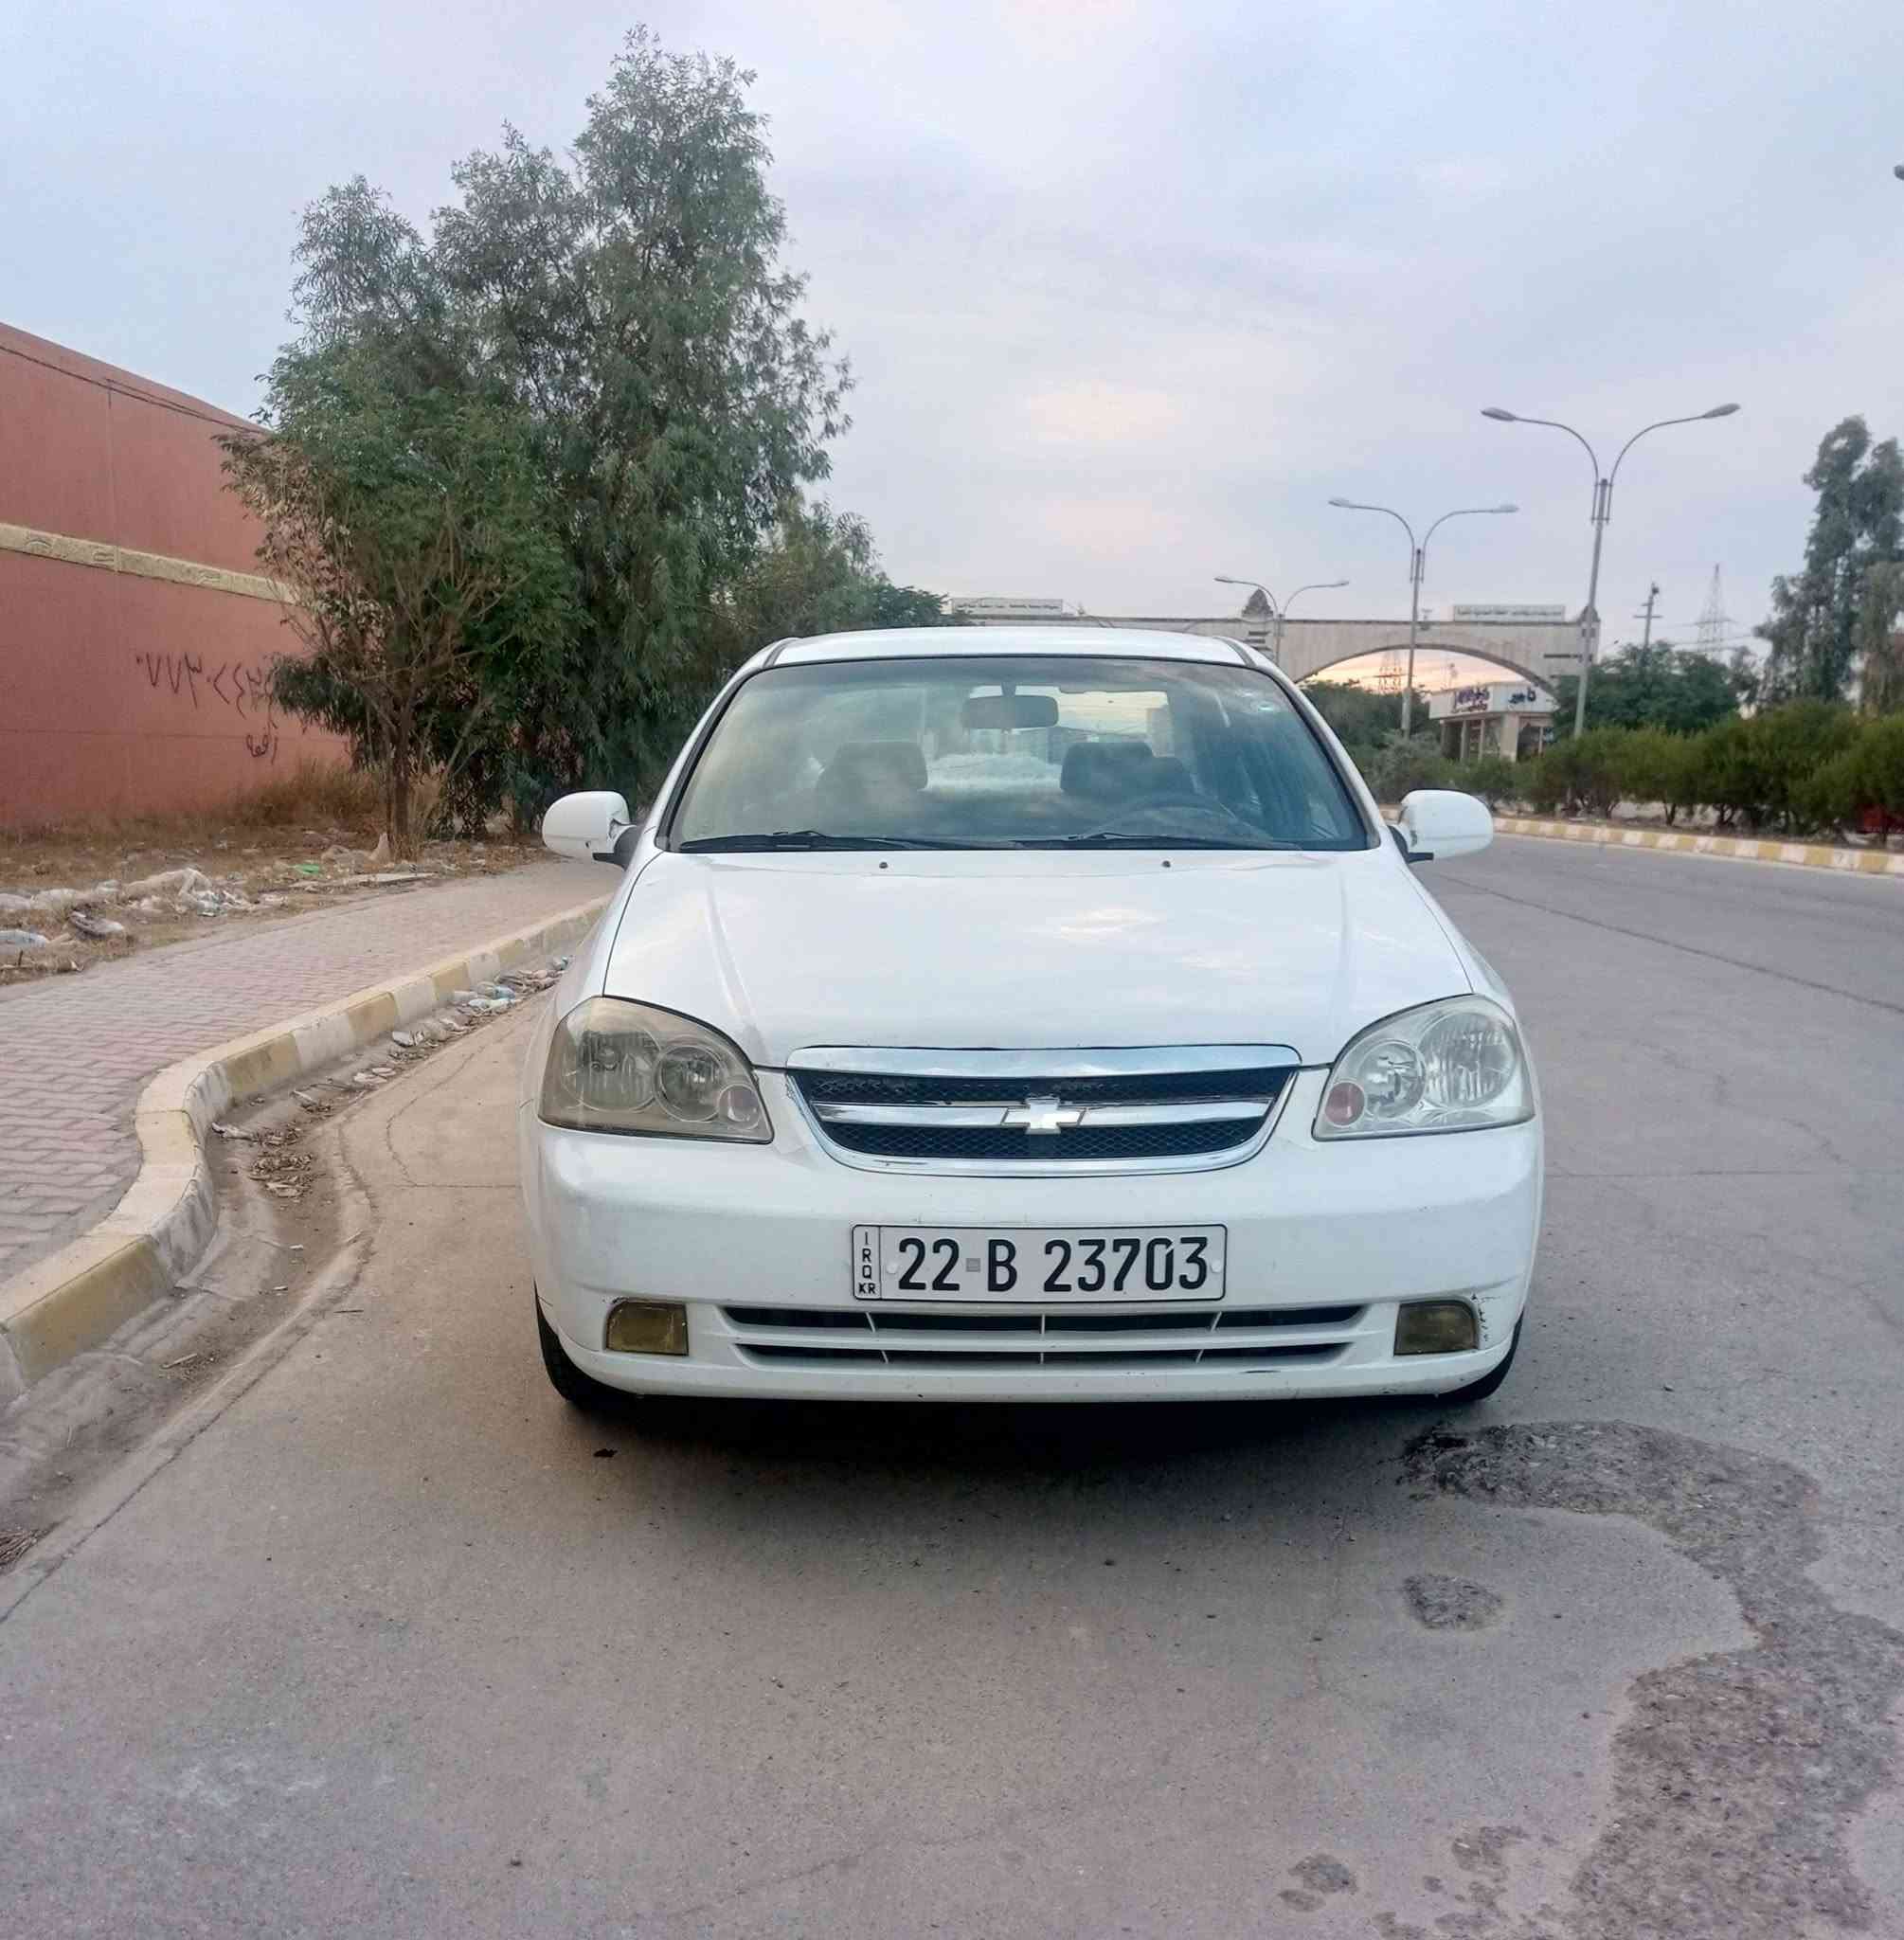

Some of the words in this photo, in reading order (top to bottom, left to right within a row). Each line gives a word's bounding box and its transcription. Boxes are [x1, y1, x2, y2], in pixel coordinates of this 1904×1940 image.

[861, 1231, 872, 1280] IRQ
[898, 1237, 961, 1291] 22
[987, 1239, 1018, 1292] B
[1043, 1237, 1209, 1292] 23703
[858, 1283, 876, 1294] KR
